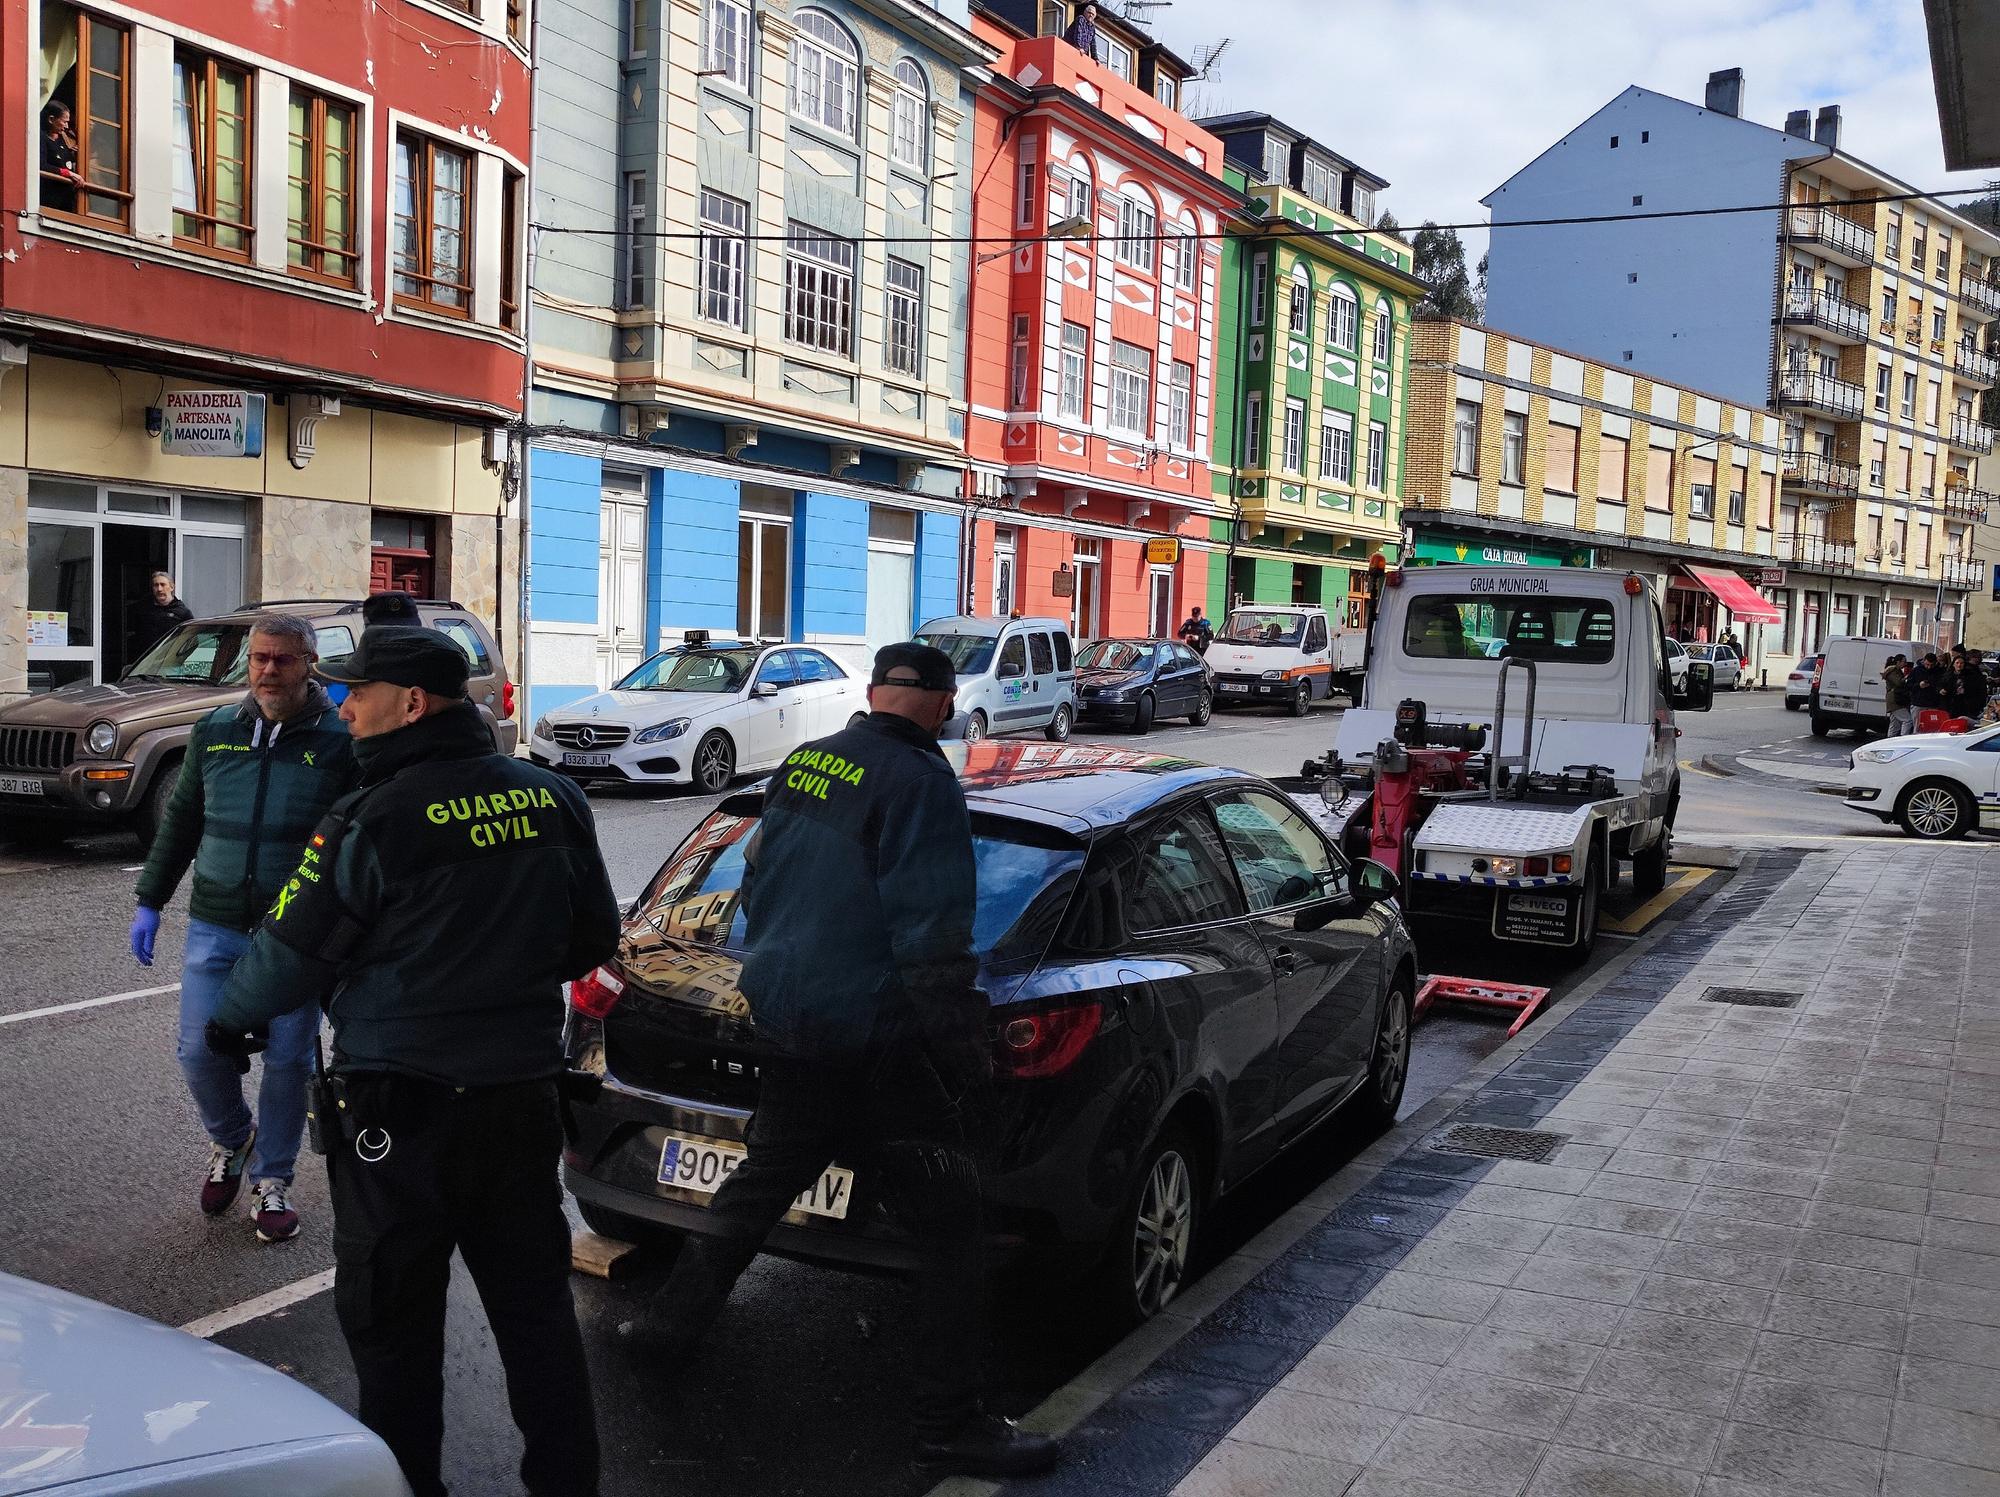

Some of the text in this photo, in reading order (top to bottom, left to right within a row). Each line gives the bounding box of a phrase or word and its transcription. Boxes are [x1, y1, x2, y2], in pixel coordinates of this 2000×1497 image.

[167, 394, 242, 408] PANADERIA
[176, 413, 231, 424] ARTESANA
[174, 428, 231, 441] MANOLITA
[1483, 547, 1528, 565] CAJA RURAL
[1470, 578, 1549, 593] GRUA MUNICIPAL
[207, 744, 232, 752] GUARDIA
[567, 755, 607, 765] 3326 JLV
[787, 750, 865, 786] GUARDIA
[787, 769, 831, 800] CIVIL
[426, 787, 558, 825] GUARDIA
[470, 815, 539, 847] CIVIL
[1529, 899, 1565, 912] IVECO
[712, 1058, 760, 1078] IBI
[678, 1147, 739, 1186] 905
